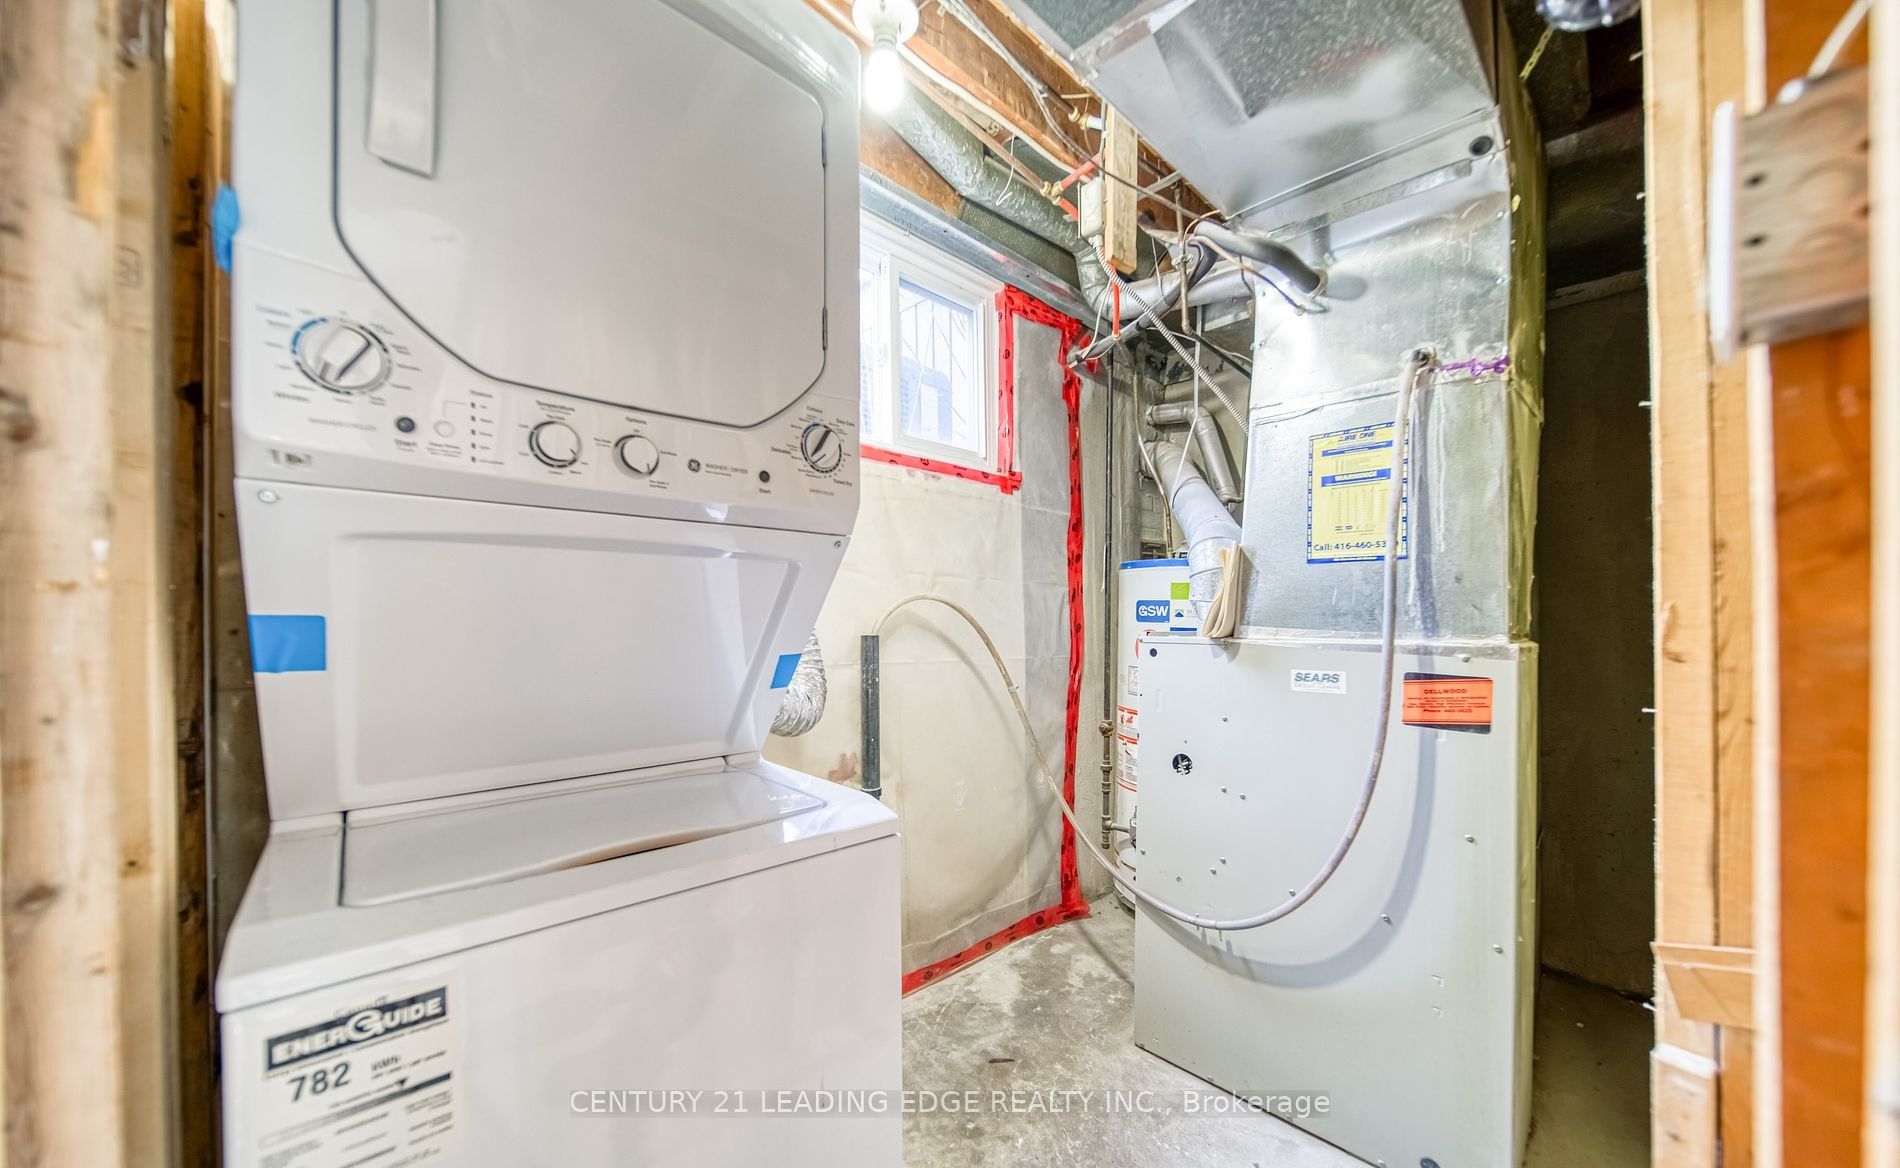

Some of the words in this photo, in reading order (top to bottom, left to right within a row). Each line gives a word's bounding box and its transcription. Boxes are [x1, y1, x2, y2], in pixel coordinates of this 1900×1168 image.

[705, 463, 728, 472] WASHER
[1313, 542, 1332, 551] Call:
[1334, 541, 1387, 550] 416-460-53
[1138, 605, 1169, 617] GSW
[1294, 672, 1340, 683] SEARS
[271, 997, 443, 1065] ENERGUIDE
[287, 1061, 352, 1104] 782
